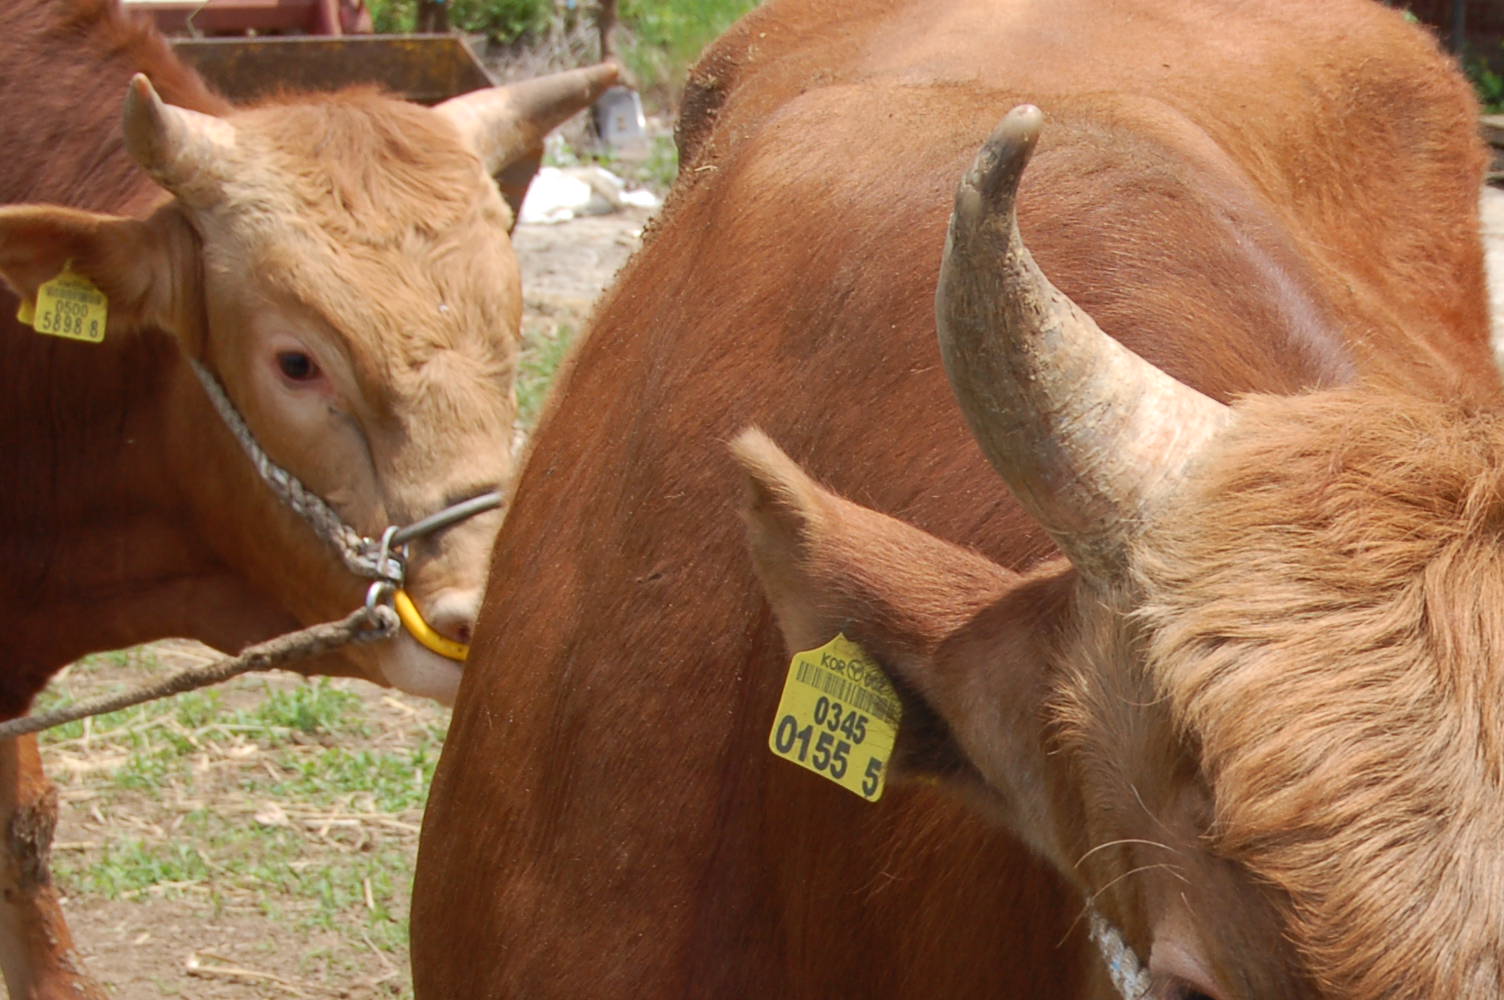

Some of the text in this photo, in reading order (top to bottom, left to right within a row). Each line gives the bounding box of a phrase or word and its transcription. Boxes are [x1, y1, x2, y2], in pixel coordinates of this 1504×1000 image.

[42, 311, 82, 334] 5898
[821, 652, 847, 675] KOR
[814, 696, 869, 745] 0345
[775, 715, 883, 797] 0155 5
